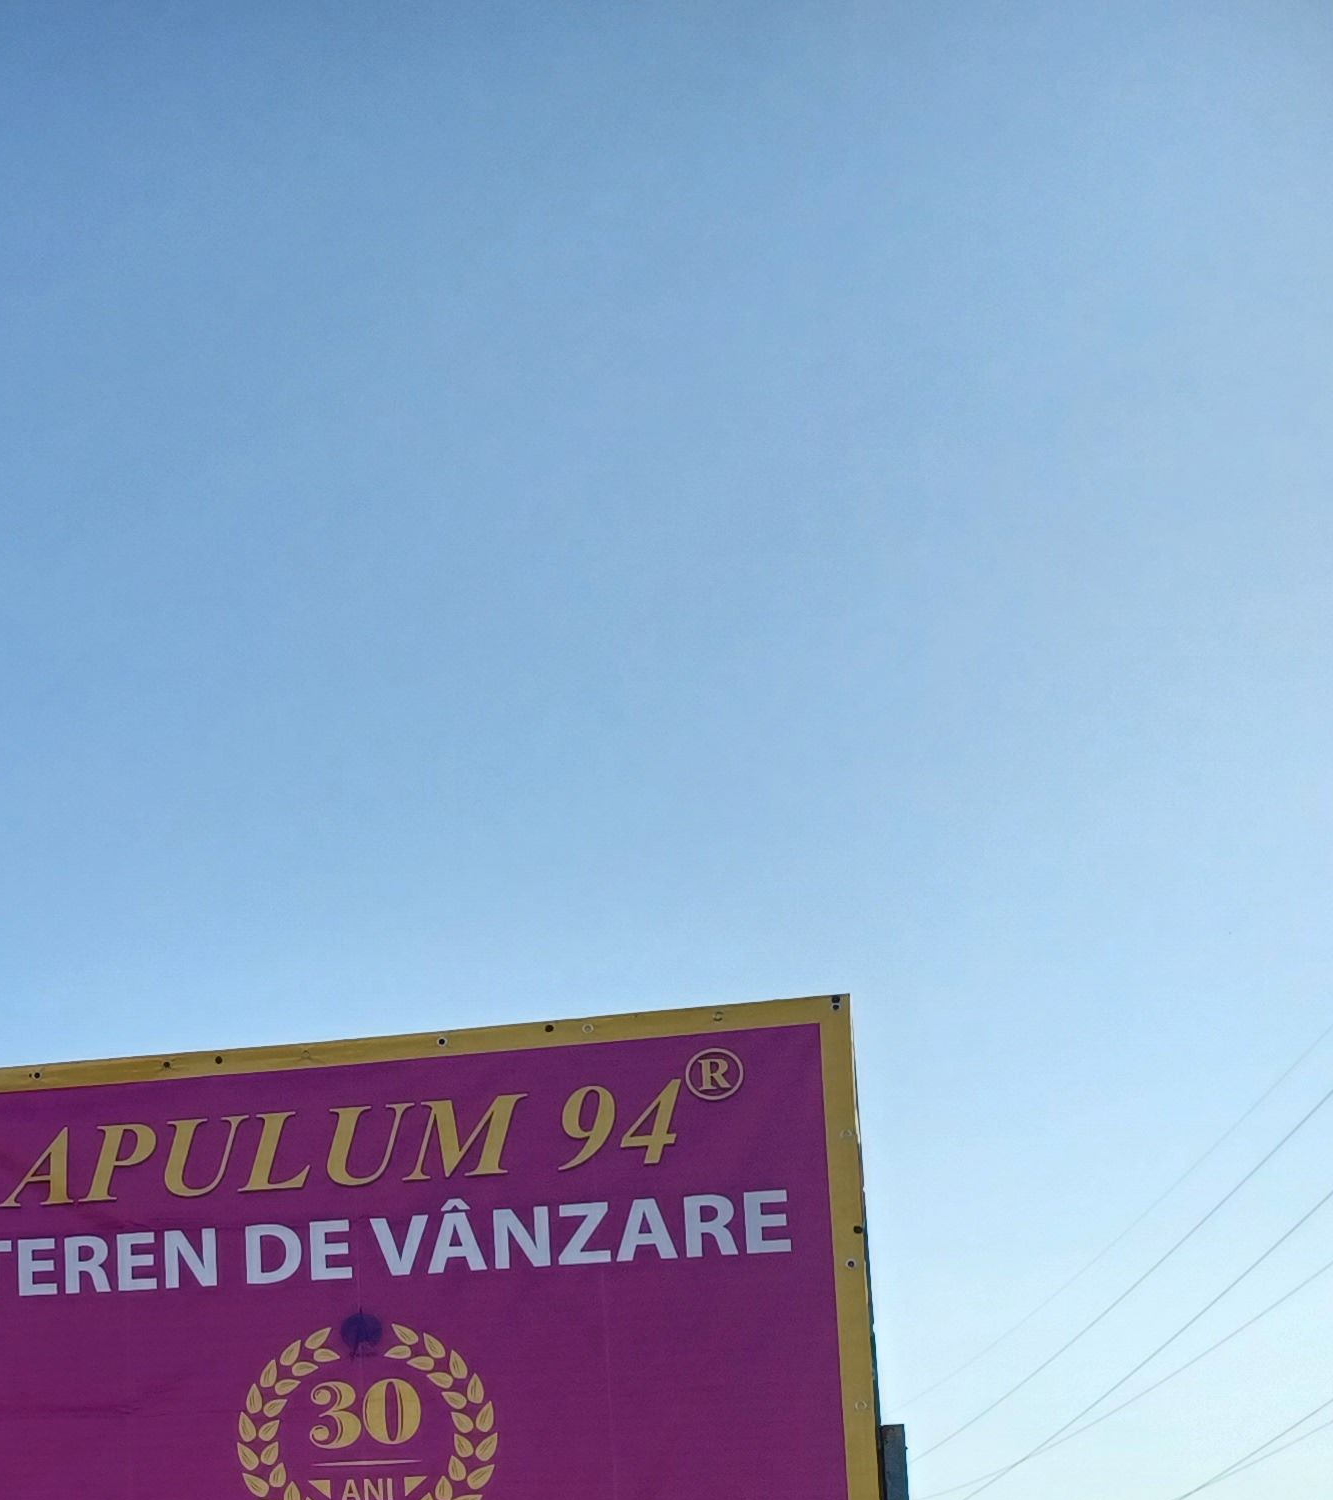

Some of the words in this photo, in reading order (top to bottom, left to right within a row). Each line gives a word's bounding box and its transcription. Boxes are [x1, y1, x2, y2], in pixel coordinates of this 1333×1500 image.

[244, 1219, 353, 1285] DE
[369, 1188, 793, 1277] VÂNZARE
[309, 1377, 422, 1449] 30
